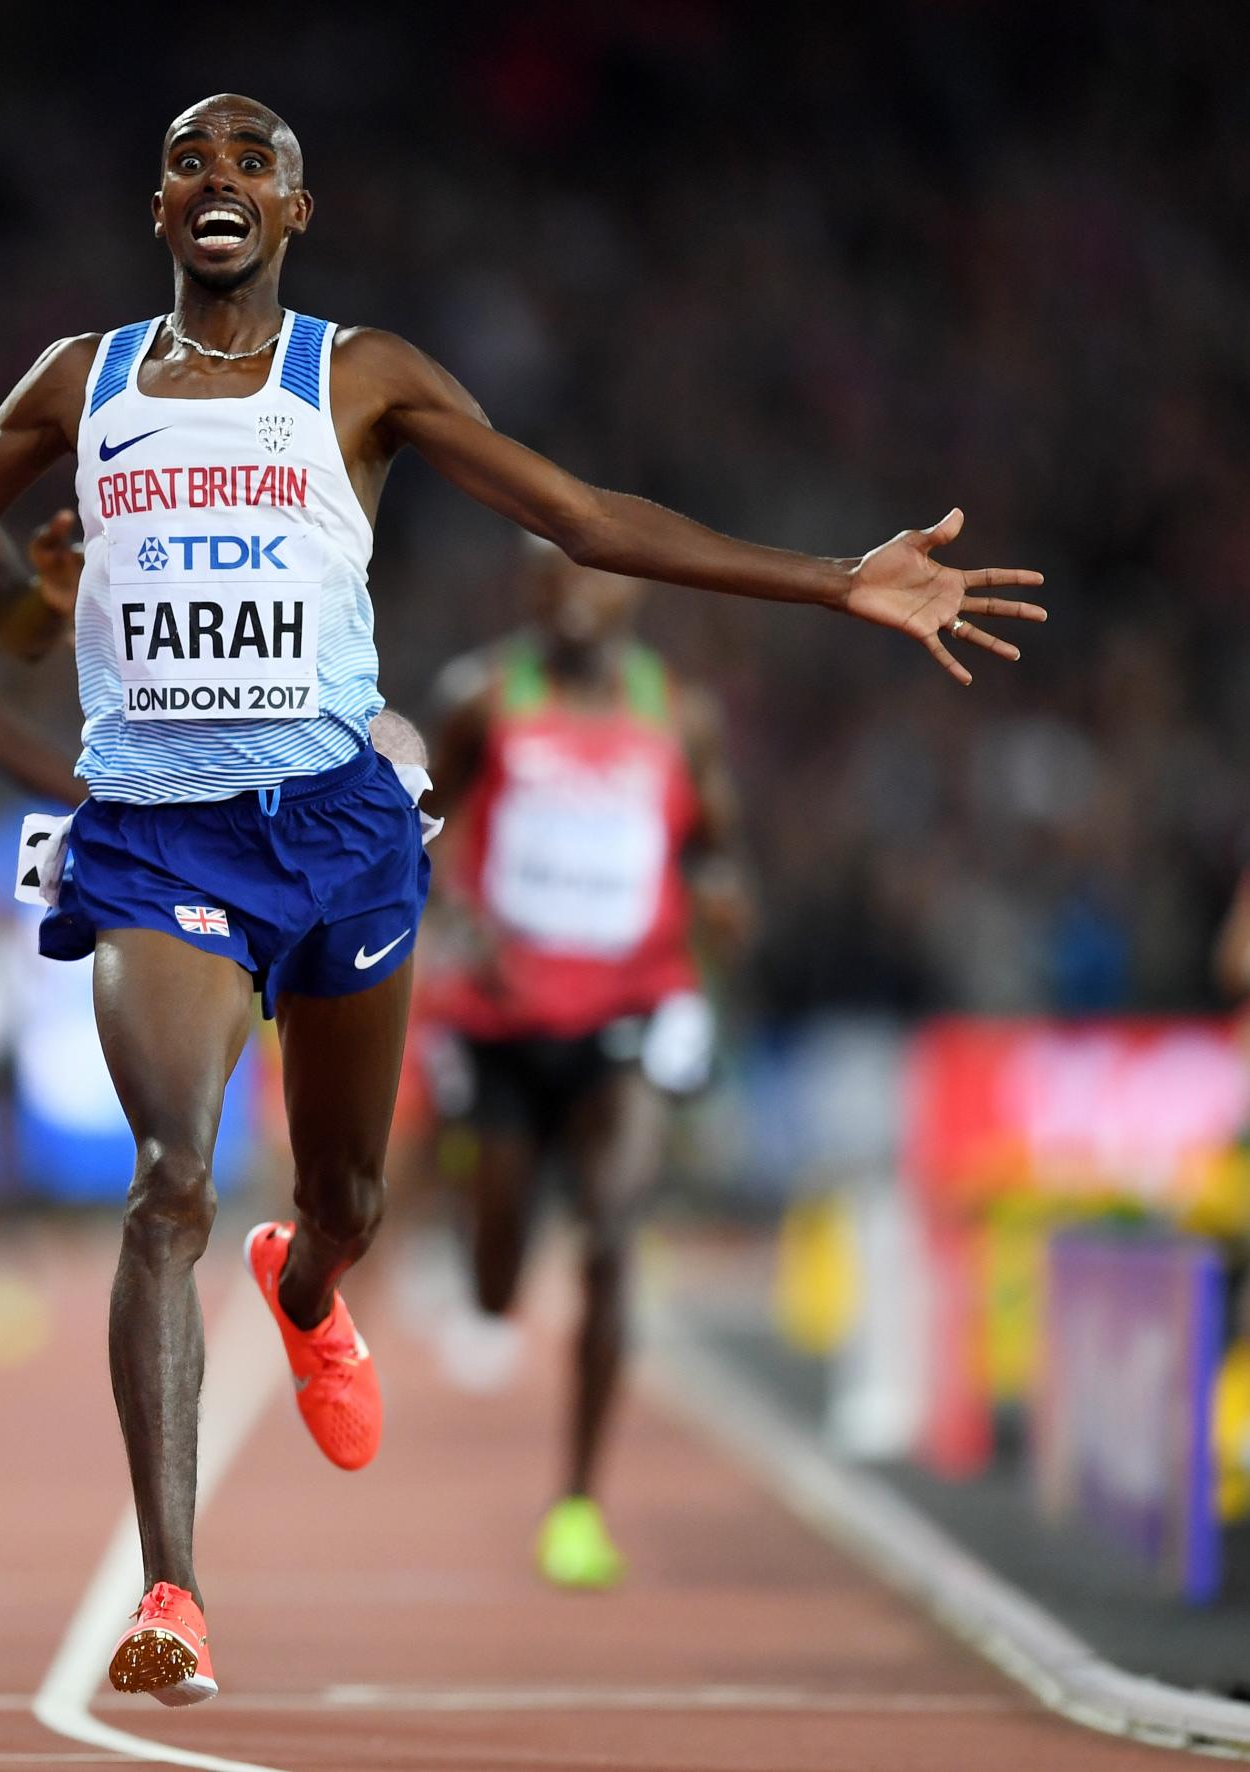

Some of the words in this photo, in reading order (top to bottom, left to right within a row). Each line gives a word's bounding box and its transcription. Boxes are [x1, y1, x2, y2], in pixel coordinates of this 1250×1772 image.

[97, 467, 183, 519] GREAT
[189, 465, 308, 509] BRITAIN
[168, 535, 289, 570] TDK
[122, 600, 304, 661] FARAH
[128, 685, 241, 712] LONDON
[247, 684, 310, 711] 2017
